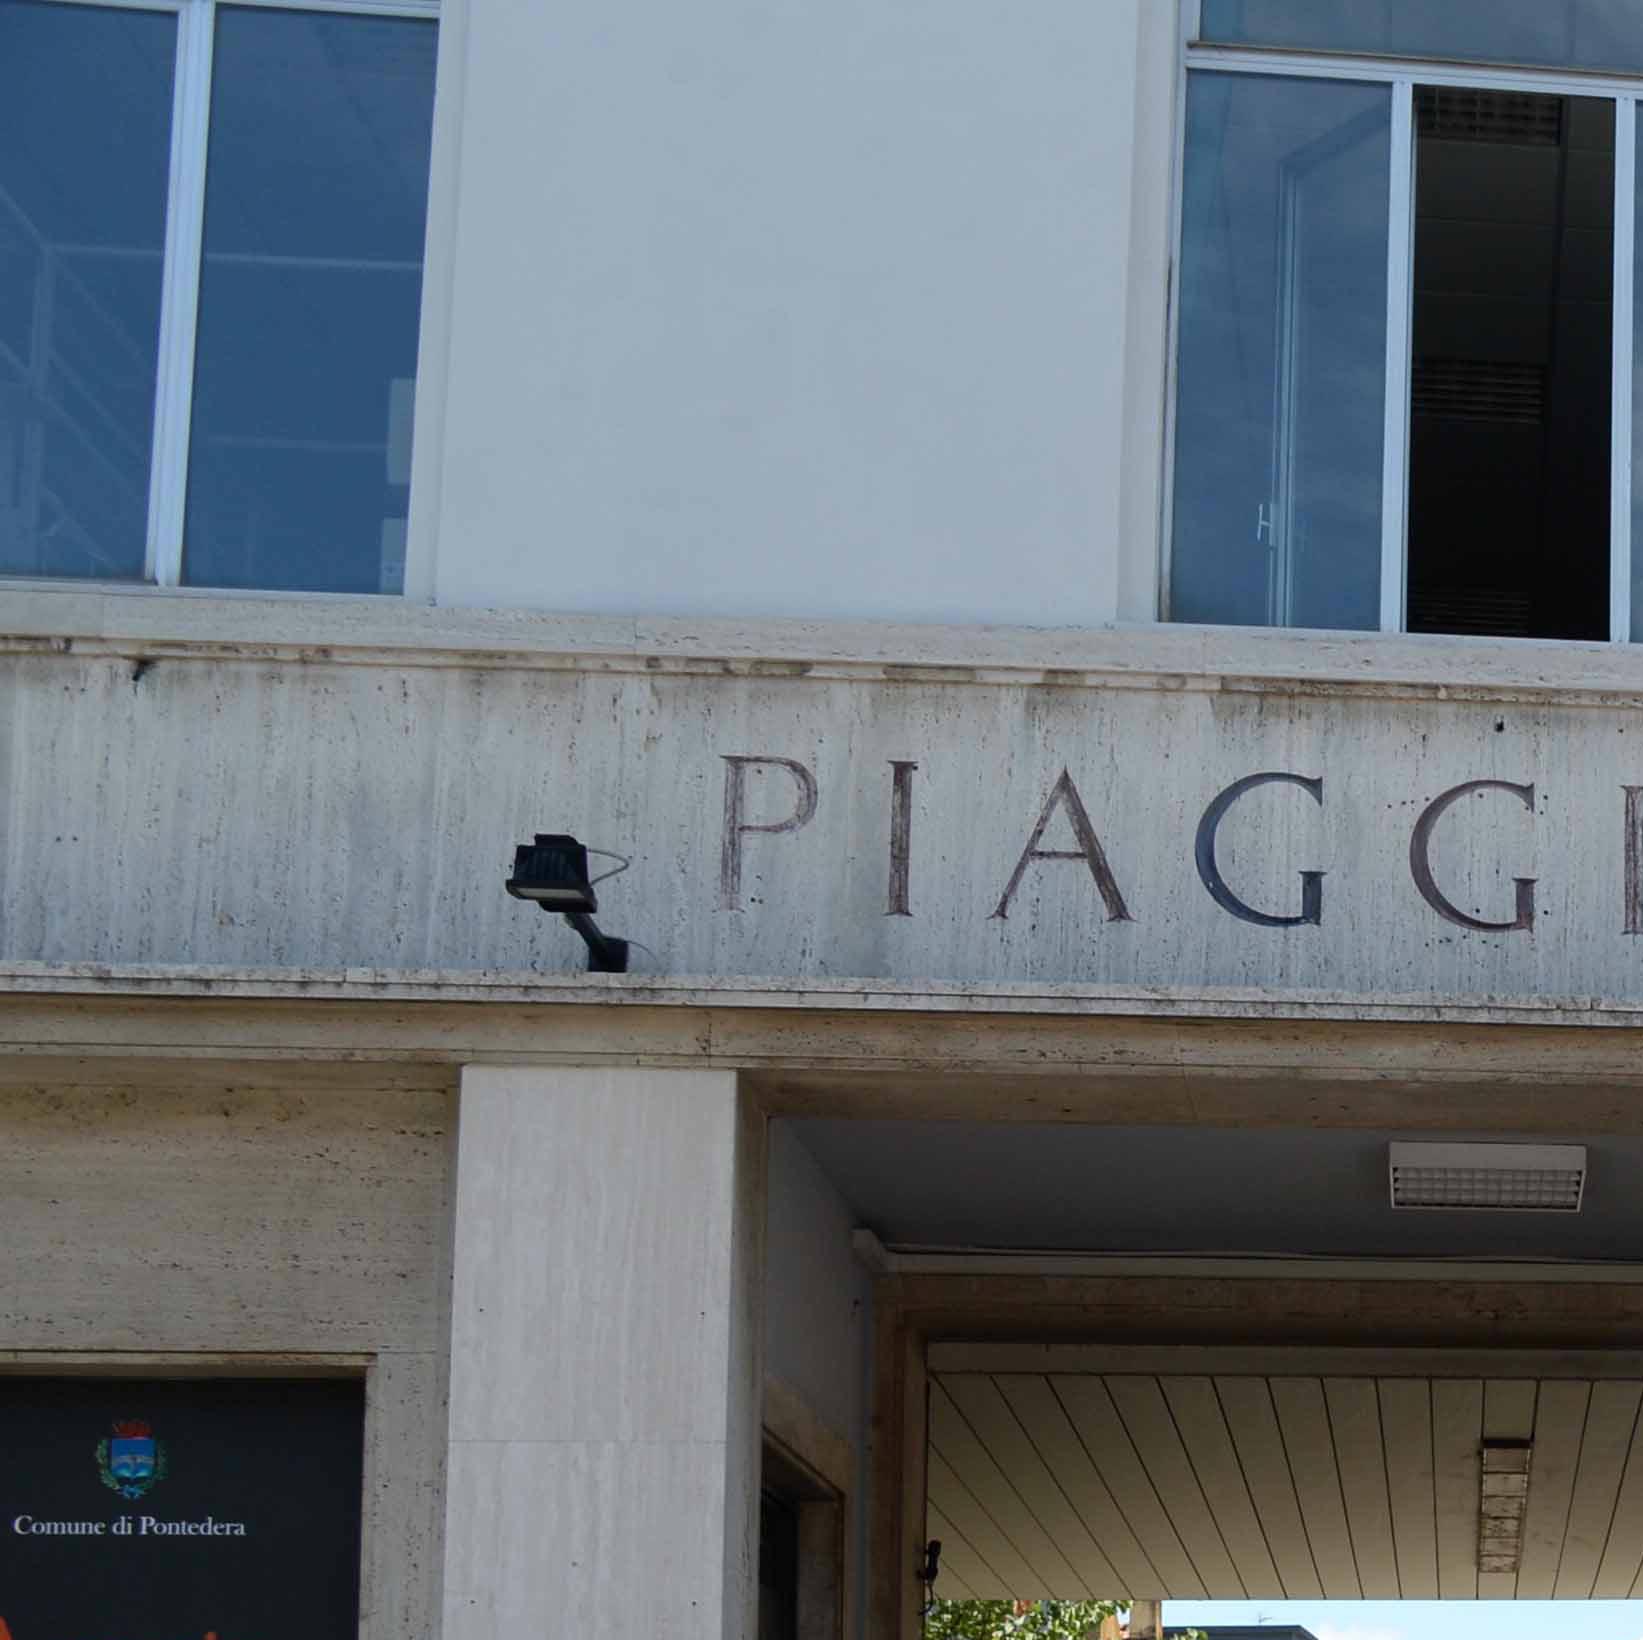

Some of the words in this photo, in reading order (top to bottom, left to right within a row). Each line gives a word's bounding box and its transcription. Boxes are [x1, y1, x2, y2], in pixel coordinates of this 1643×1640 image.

[13, 1515, 106, 1536] Comune
[112, 1515, 134, 1536] di
[140, 1515, 247, 1537] Pontedera
